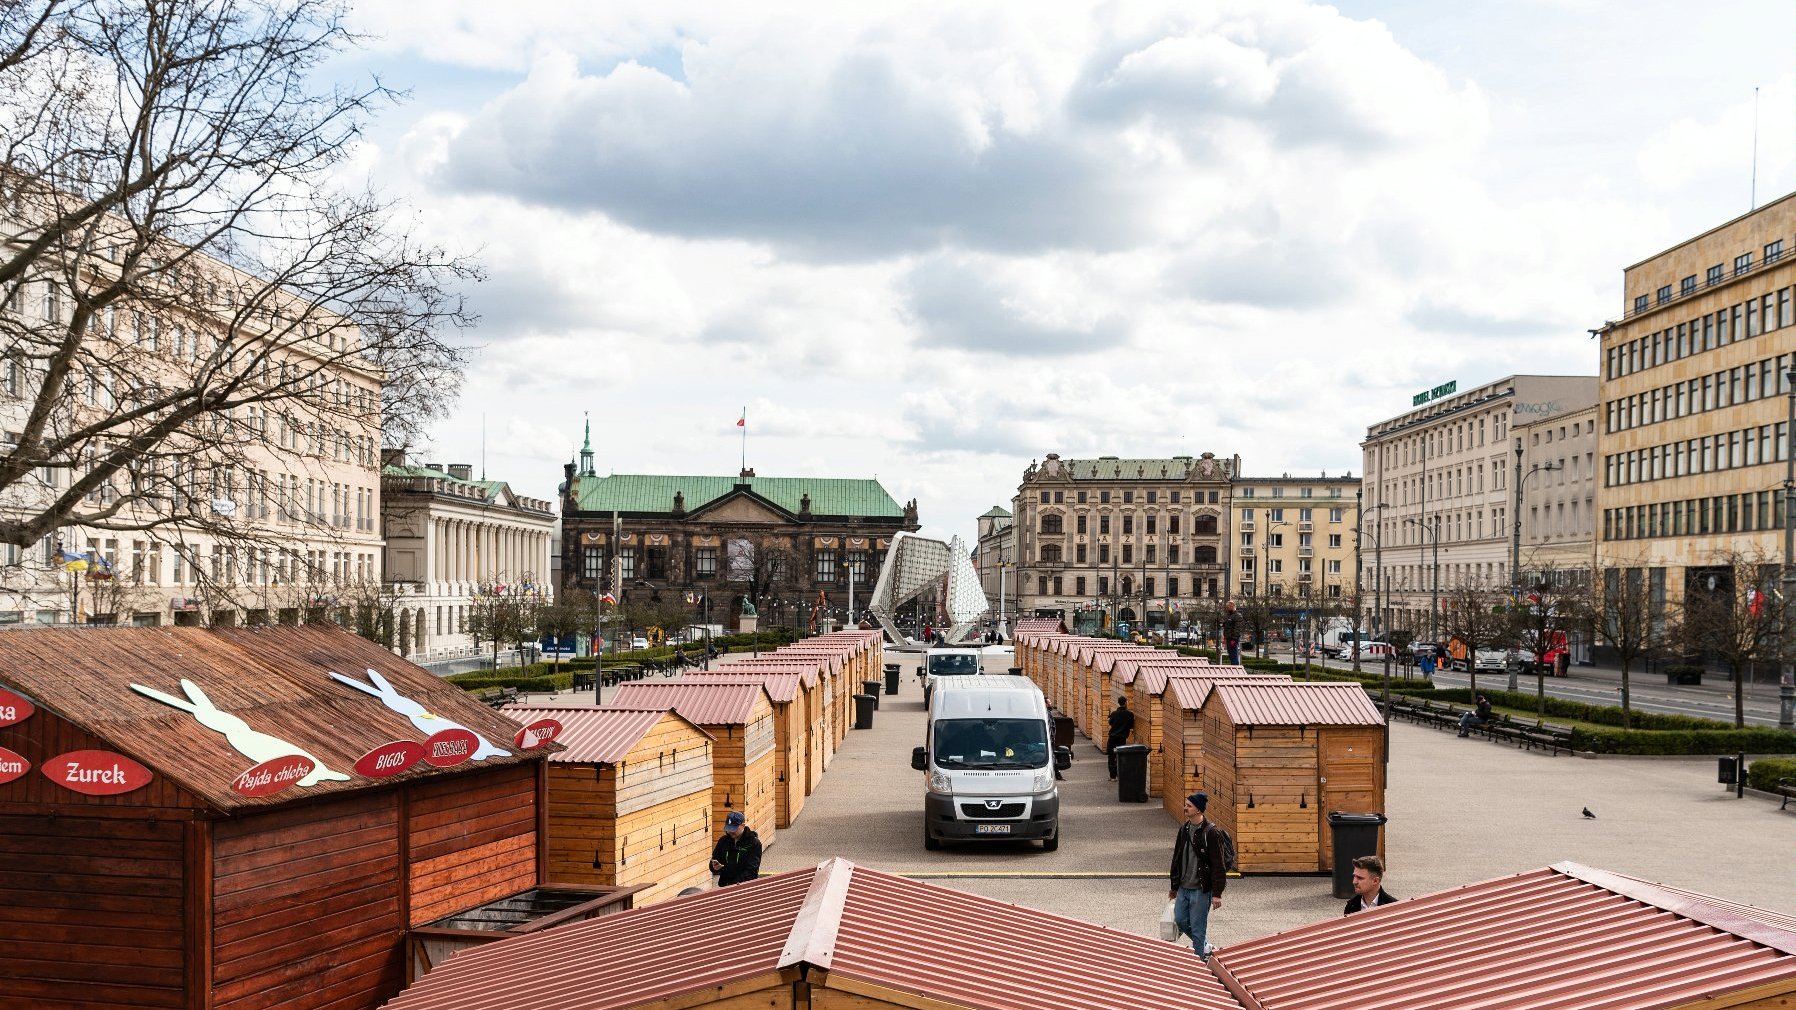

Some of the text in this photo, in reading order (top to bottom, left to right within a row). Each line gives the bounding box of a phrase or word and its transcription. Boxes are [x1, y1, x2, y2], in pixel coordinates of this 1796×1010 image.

[375, 751, 407, 770] BIGOS
[238, 763, 310, 791] Pajda chleba
